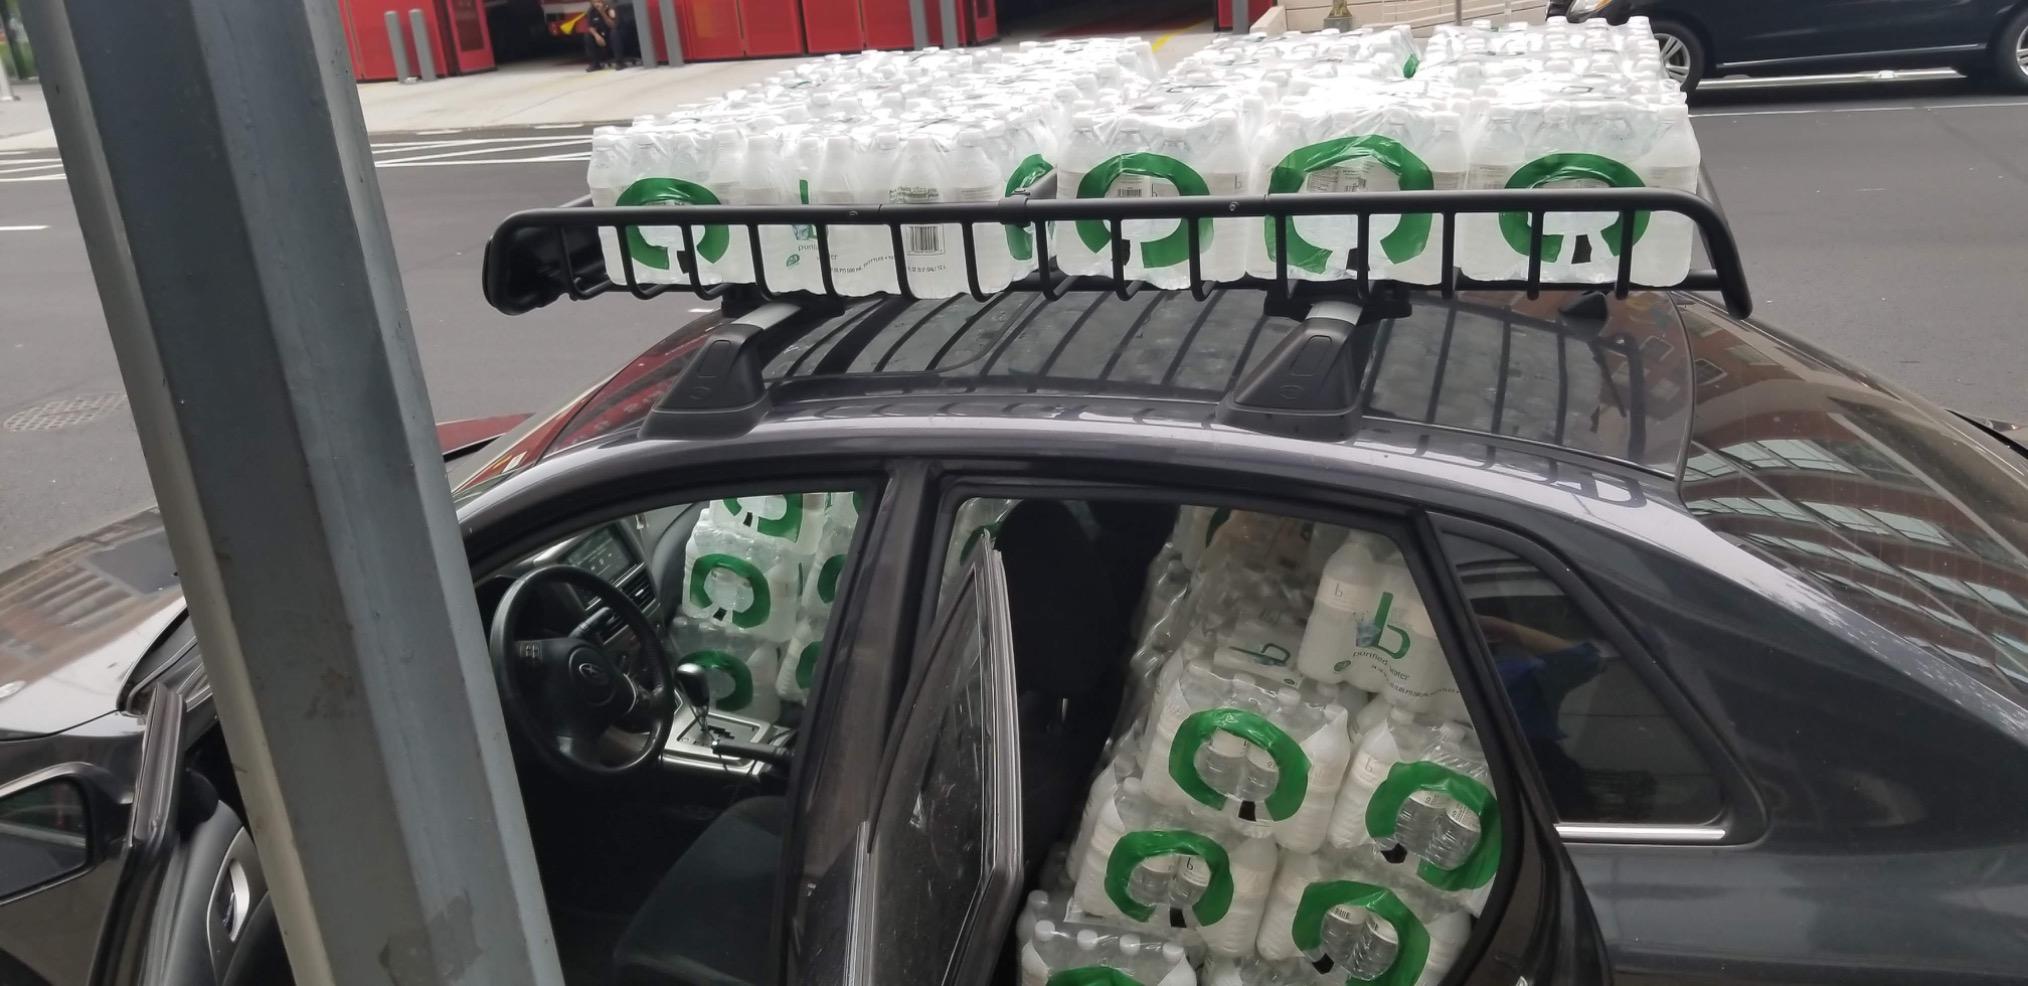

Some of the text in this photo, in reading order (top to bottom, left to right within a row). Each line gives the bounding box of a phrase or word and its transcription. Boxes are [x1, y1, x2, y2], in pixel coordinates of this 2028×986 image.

[1373, 592, 1410, 659] b
[1352, 650, 1388, 666] purified
[1186, 857, 1194, 871] b
